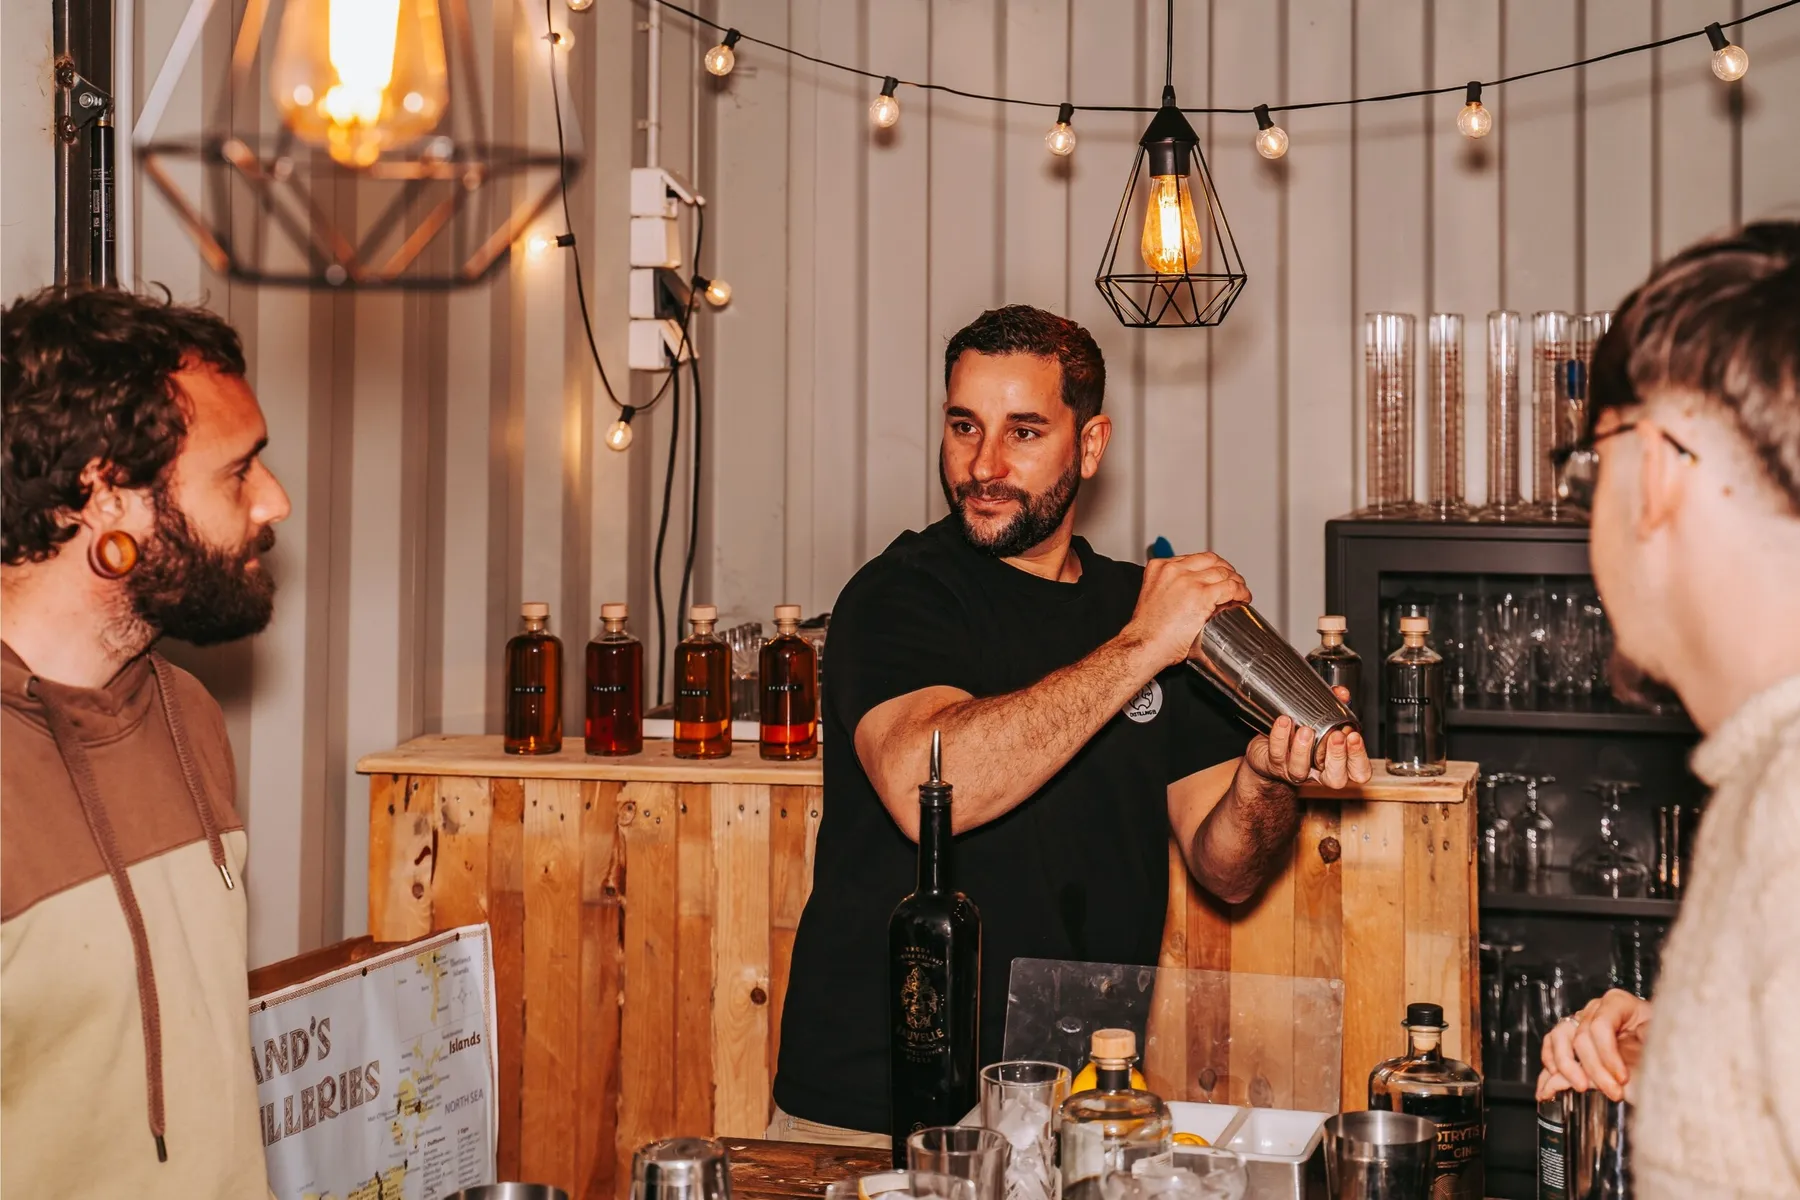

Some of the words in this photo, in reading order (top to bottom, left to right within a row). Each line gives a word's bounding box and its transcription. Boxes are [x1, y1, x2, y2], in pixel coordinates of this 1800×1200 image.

[449, 1031, 481, 1055] Islands
[444, 1095, 470, 1115] NORTH
[470, 1089, 484, 1103] SEA
[1453, 1147, 1473, 1158] GIN
